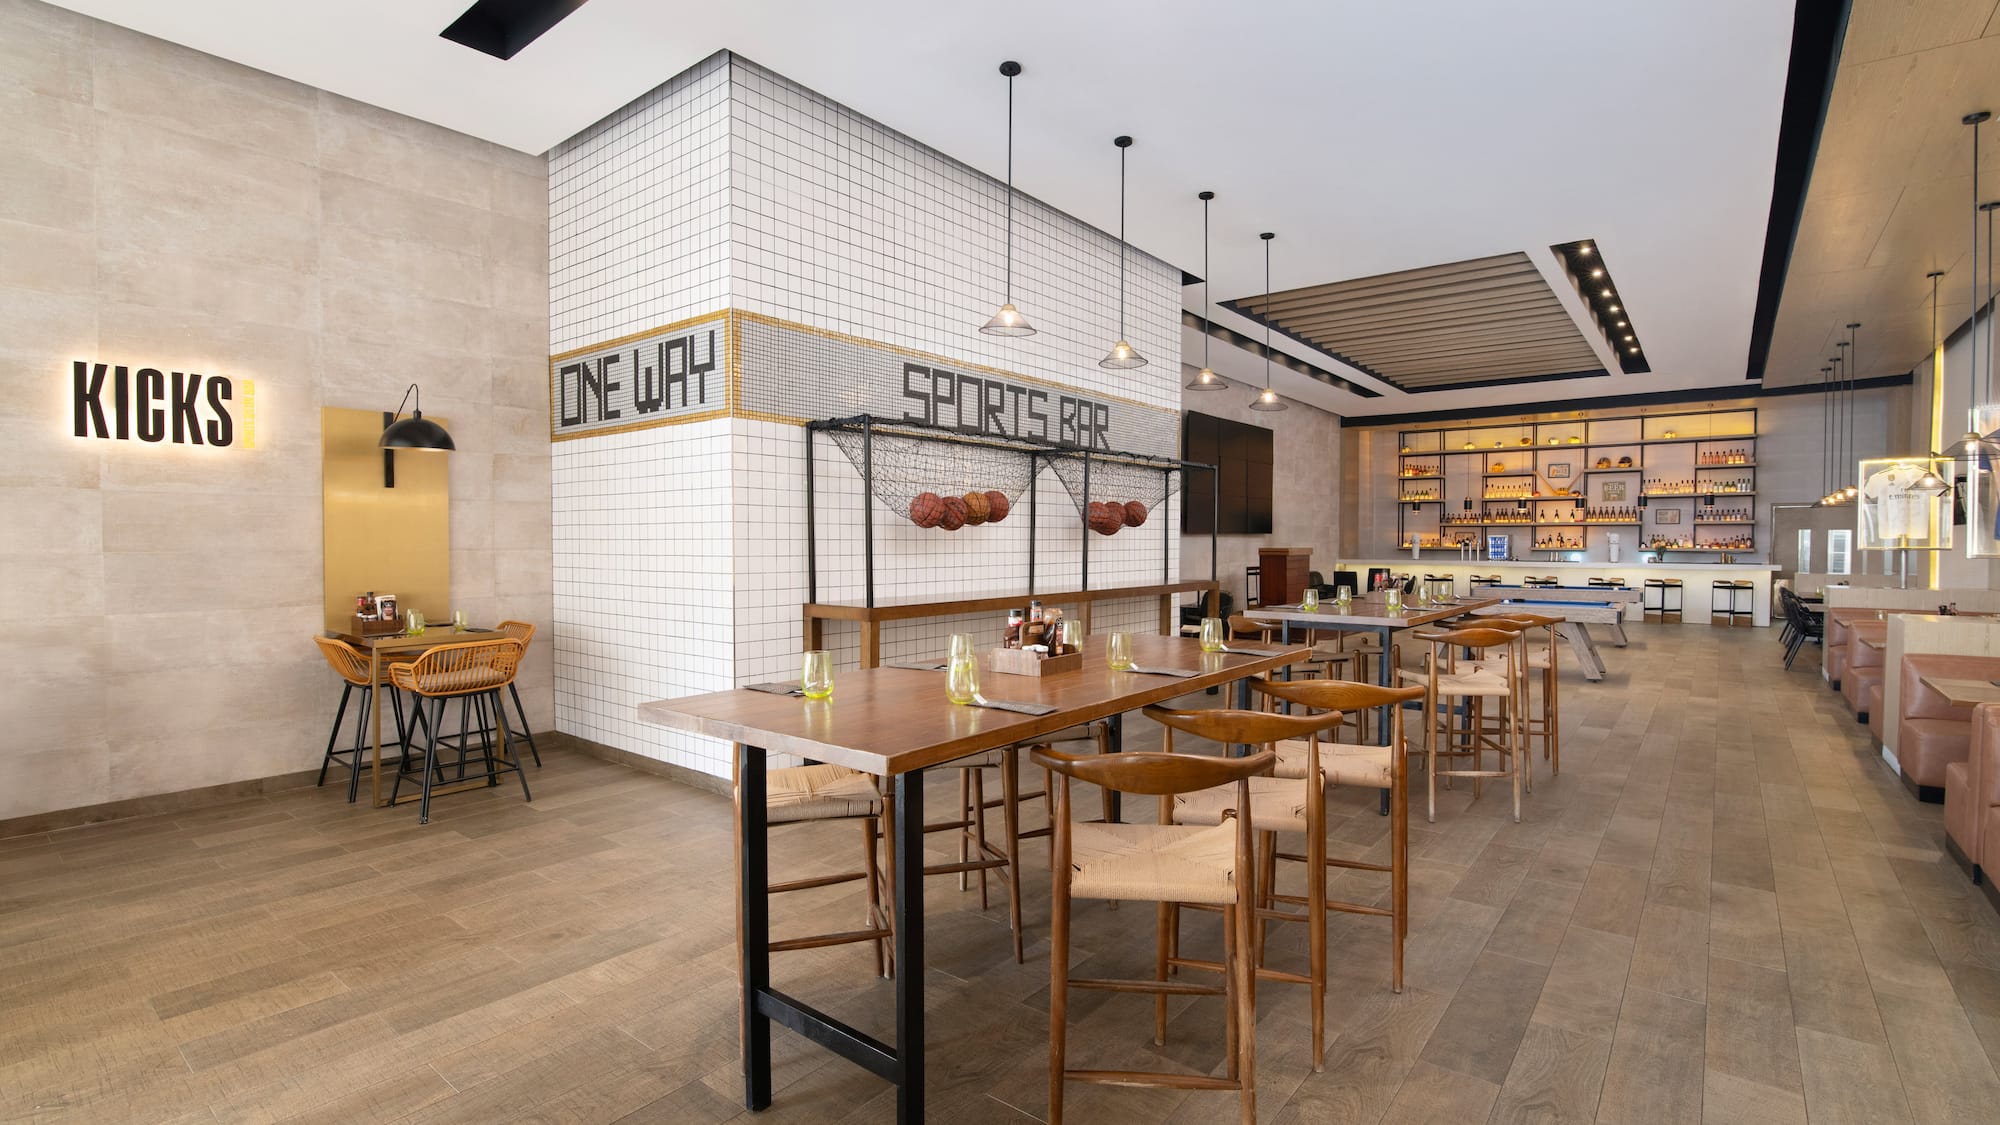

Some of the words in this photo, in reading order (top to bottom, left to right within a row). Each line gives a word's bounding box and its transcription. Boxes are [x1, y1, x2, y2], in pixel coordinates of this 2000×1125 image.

[73, 360, 233, 447] KICKS
[561, 353, 621, 427] ONE
[633, 330, 715, 415] WAY
[903, 362, 1048, 442] SPORTS
[1059, 395, 1111, 450] BAR
